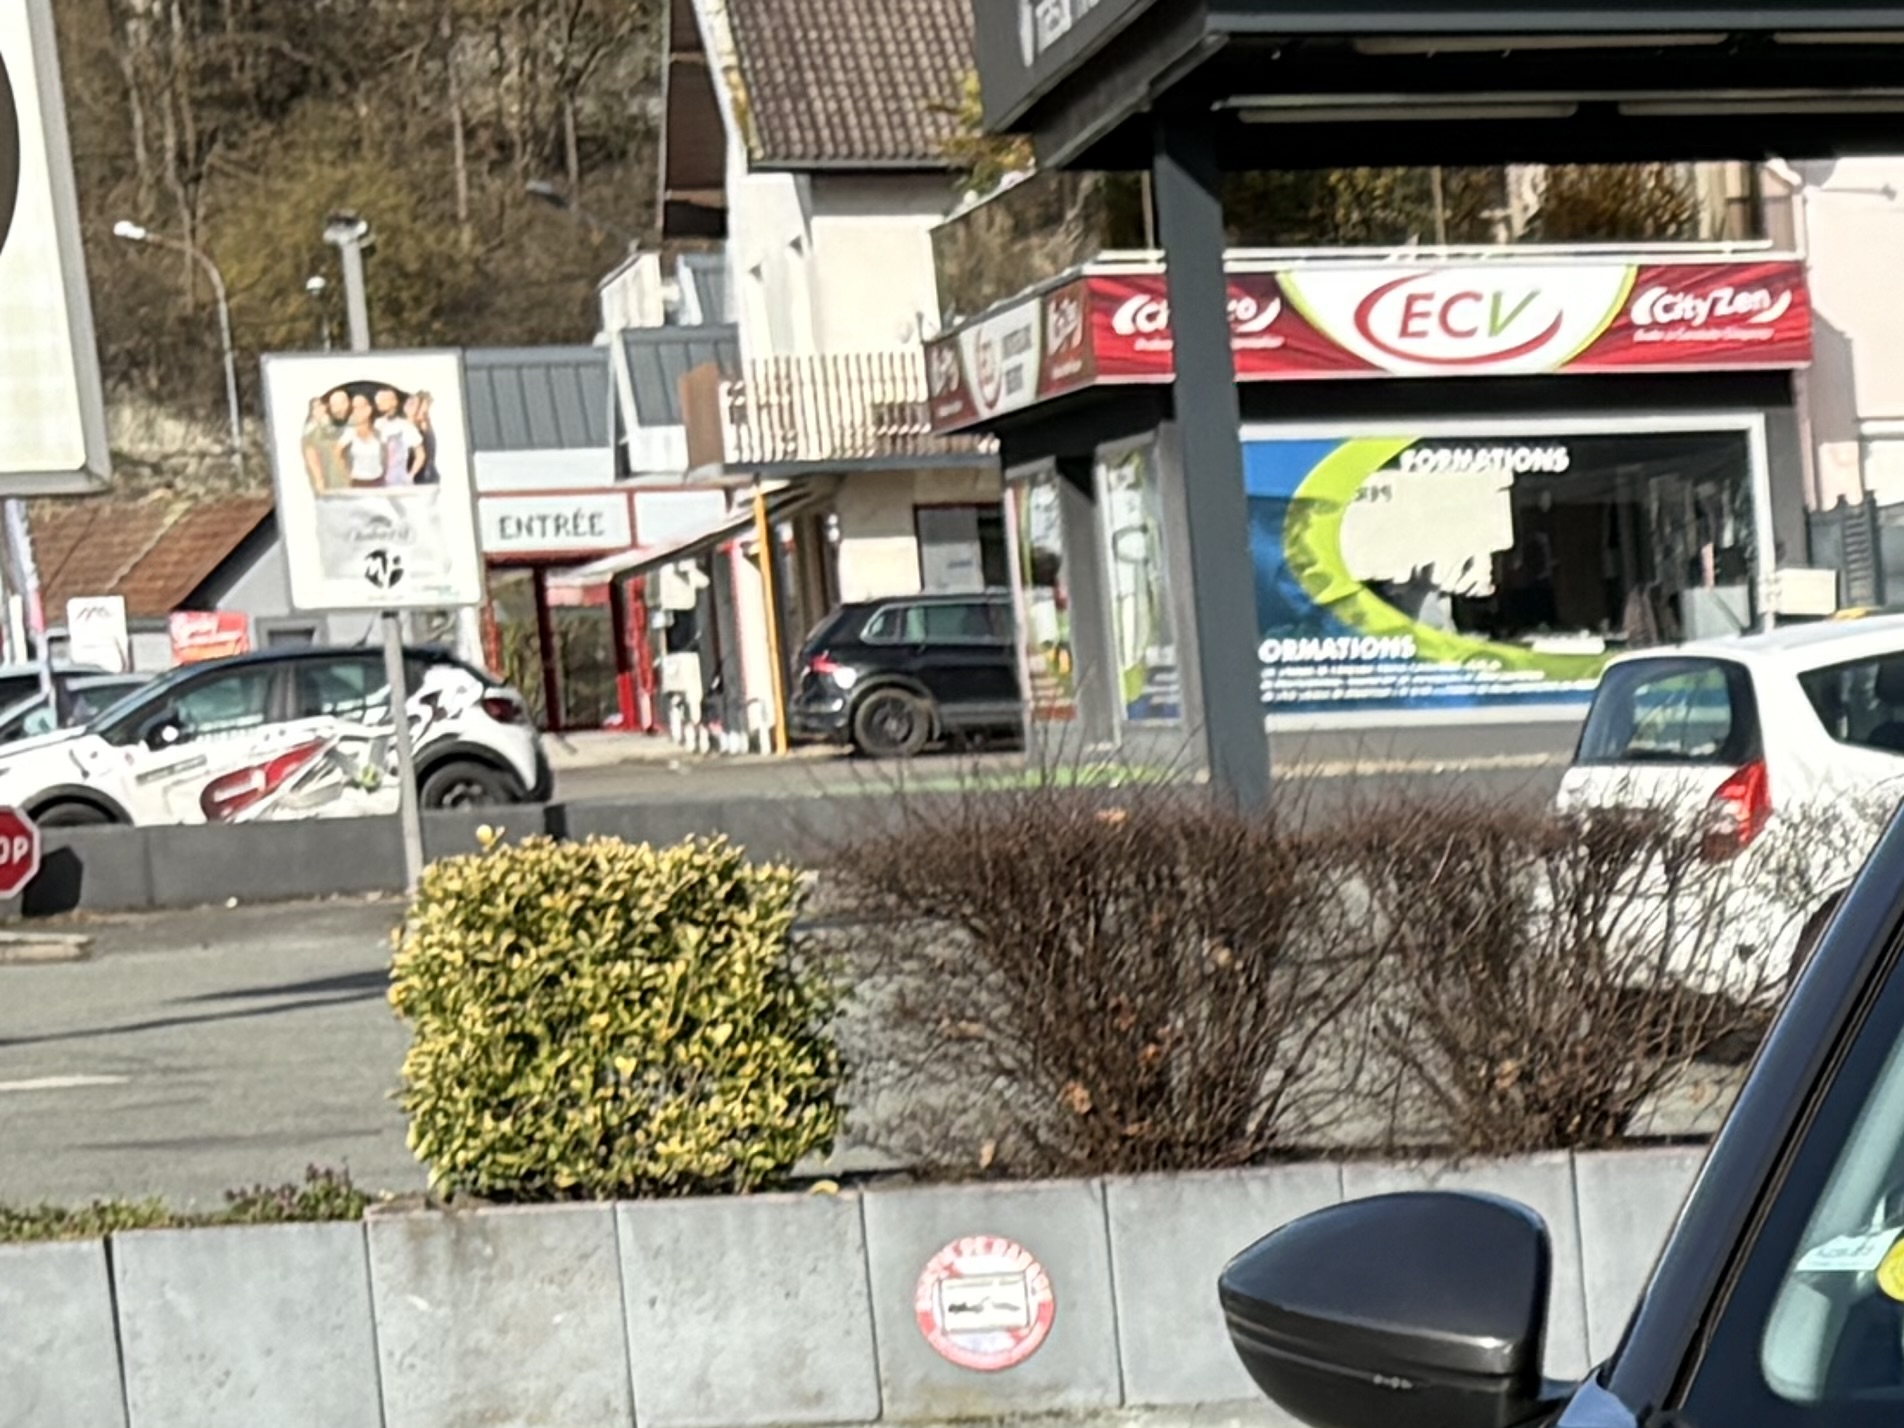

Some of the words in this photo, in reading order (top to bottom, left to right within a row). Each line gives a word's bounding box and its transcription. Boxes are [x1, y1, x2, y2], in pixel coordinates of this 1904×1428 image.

[1398, 289, 1542, 338] ECV
[1399, 446, 1570, 473] FORMATIONS
[498, 507, 606, 541] ENTRÉE
[1258, 635, 1417, 664] ORMATIONS
[0, 835, 29, 865] OP
